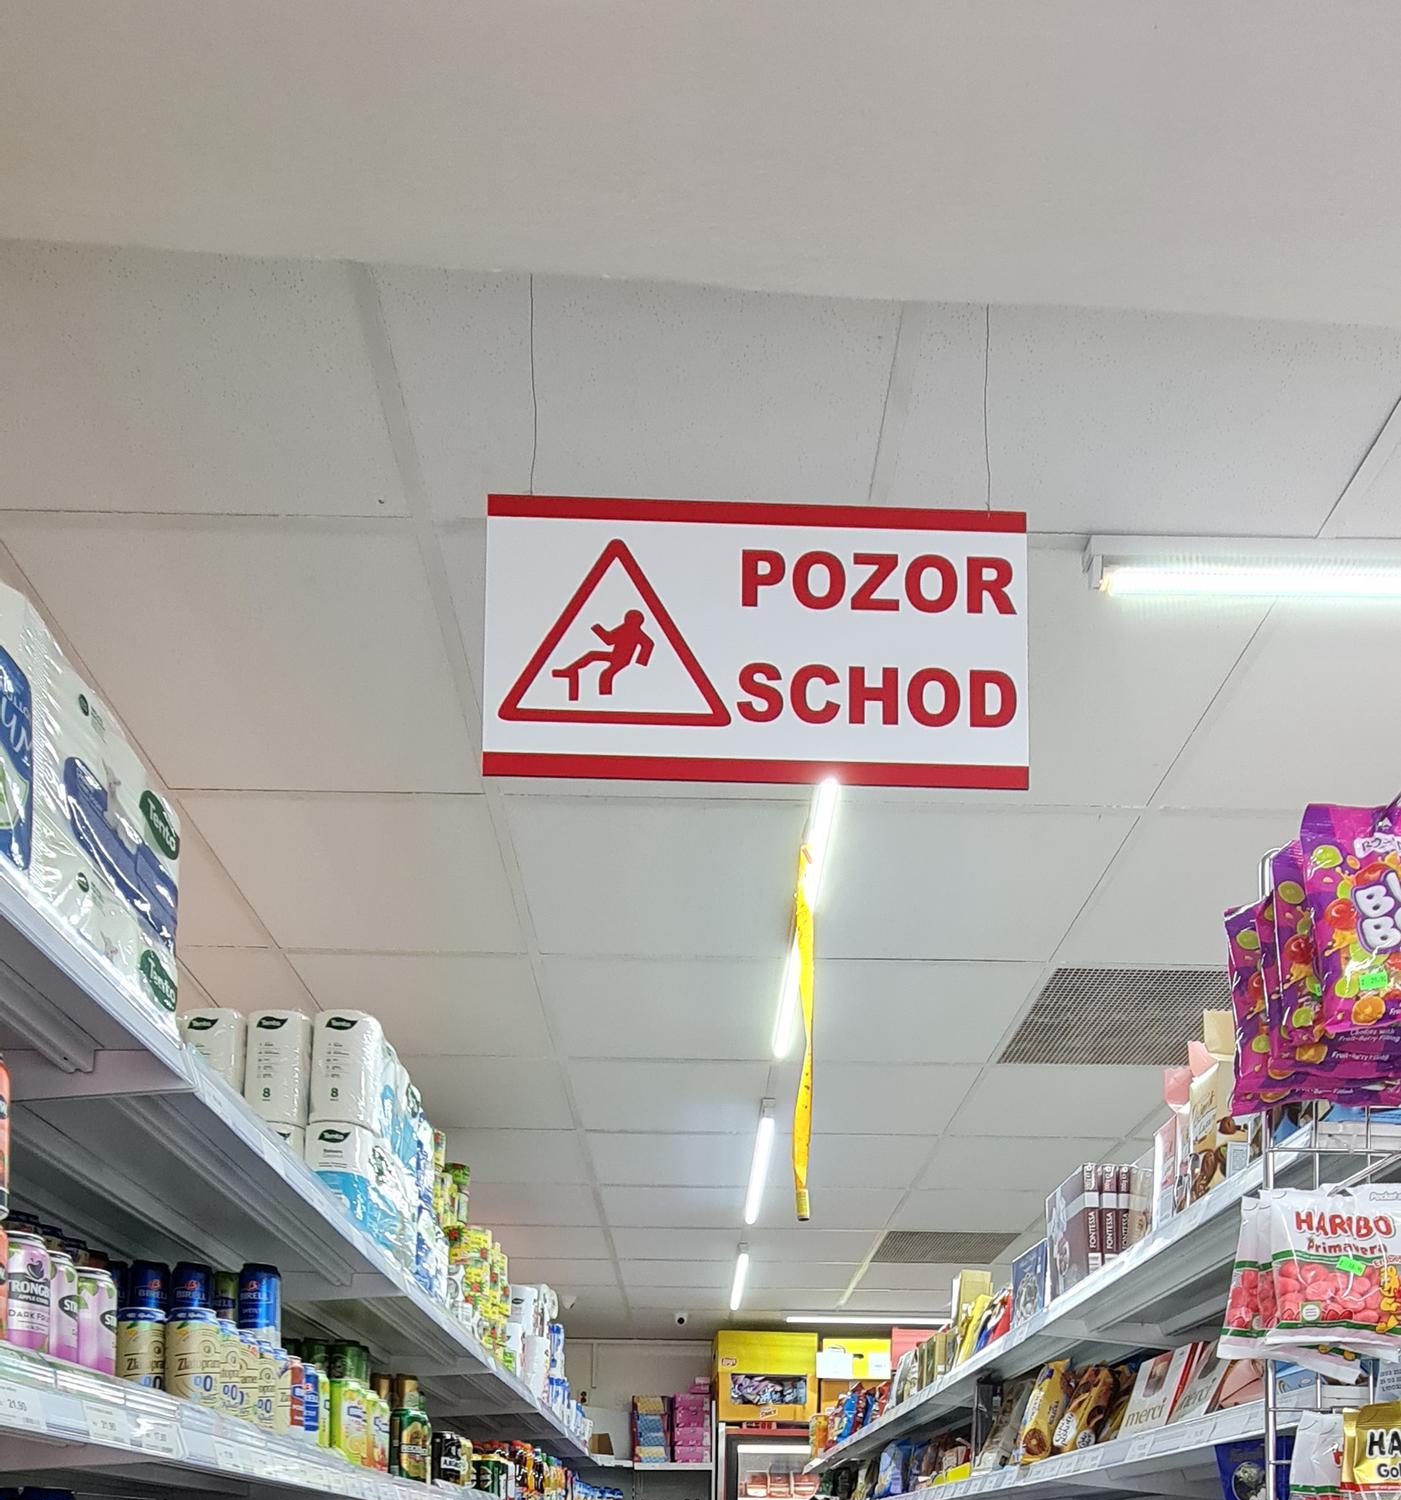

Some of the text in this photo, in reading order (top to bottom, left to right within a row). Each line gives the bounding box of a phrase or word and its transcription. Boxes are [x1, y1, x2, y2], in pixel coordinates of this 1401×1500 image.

[741, 550, 1017, 615] POZOR
[736, 662, 1018, 728] SCHOD
[147, 799, 178, 853] Tento
[263, 1087, 271, 1098] 8
[331, 1087, 338, 1098] 8
[1088, 1210, 1097, 1249] FONTESSA
[1105, 1211, 1114, 1250] FONTESSA
[1295, 1210, 1393, 1239] HARIBO
[1307, 1235, 1388, 1256] Primavera
[8, 1308, 36, 1319] DARK
[1125, 1401, 1166, 1428] merci
